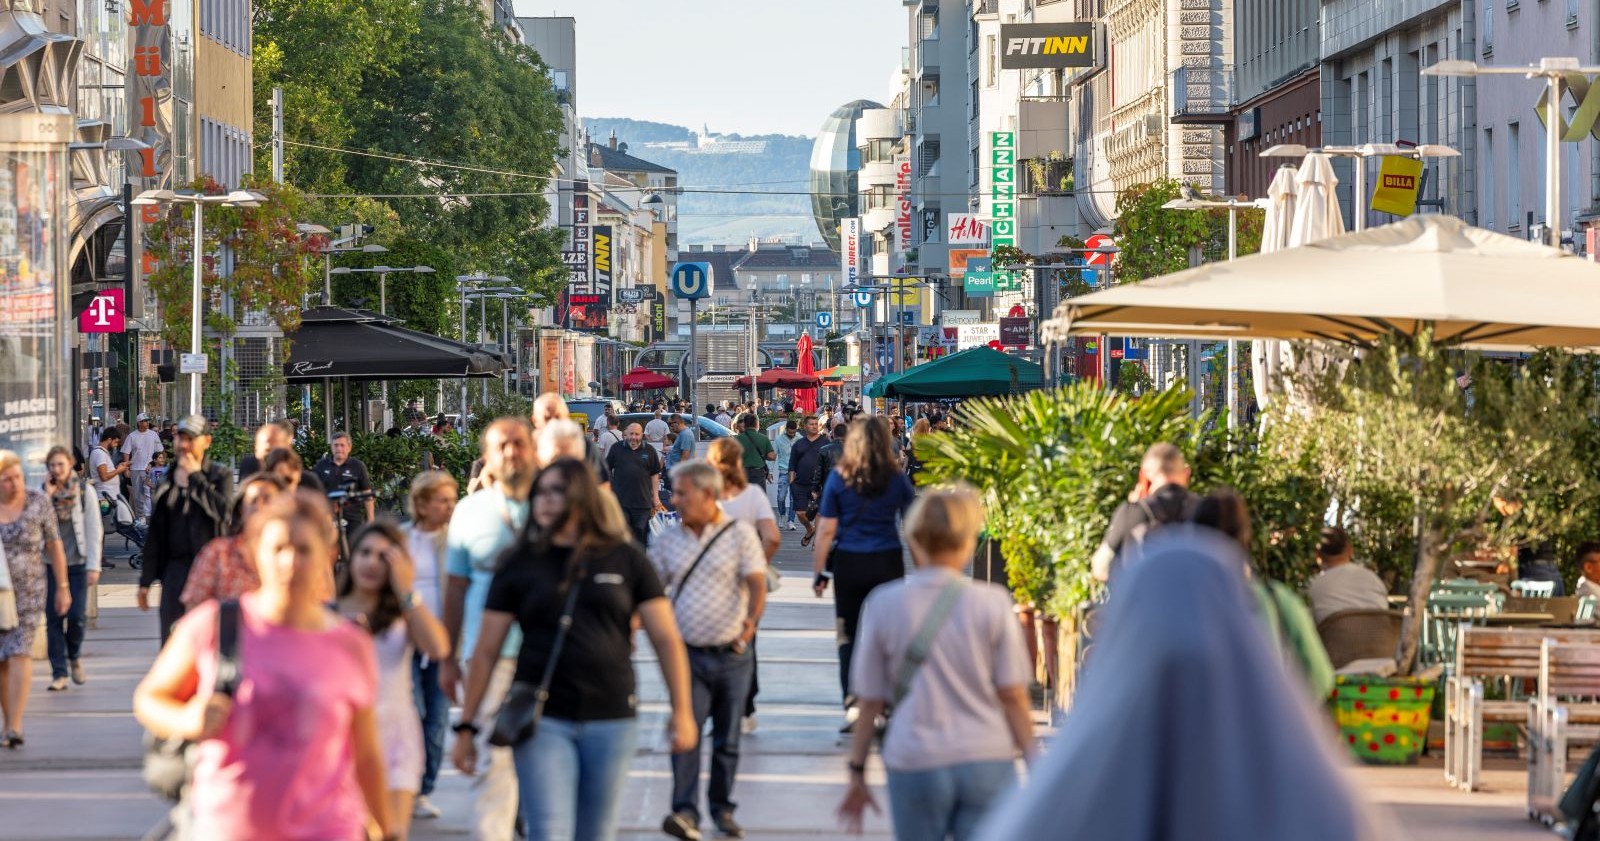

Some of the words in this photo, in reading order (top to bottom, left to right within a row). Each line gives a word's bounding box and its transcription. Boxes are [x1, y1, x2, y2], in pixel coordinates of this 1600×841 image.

[1006, 36, 1089, 56] FITINN
[1385, 176, 1413, 188] BILLA
[950, 216, 983, 240] H&M
[678, 270, 701, 295] U
[89, 295, 116, 326] T
[820, 315, 831, 326] U
[971, 326, 989, 335] STAR
